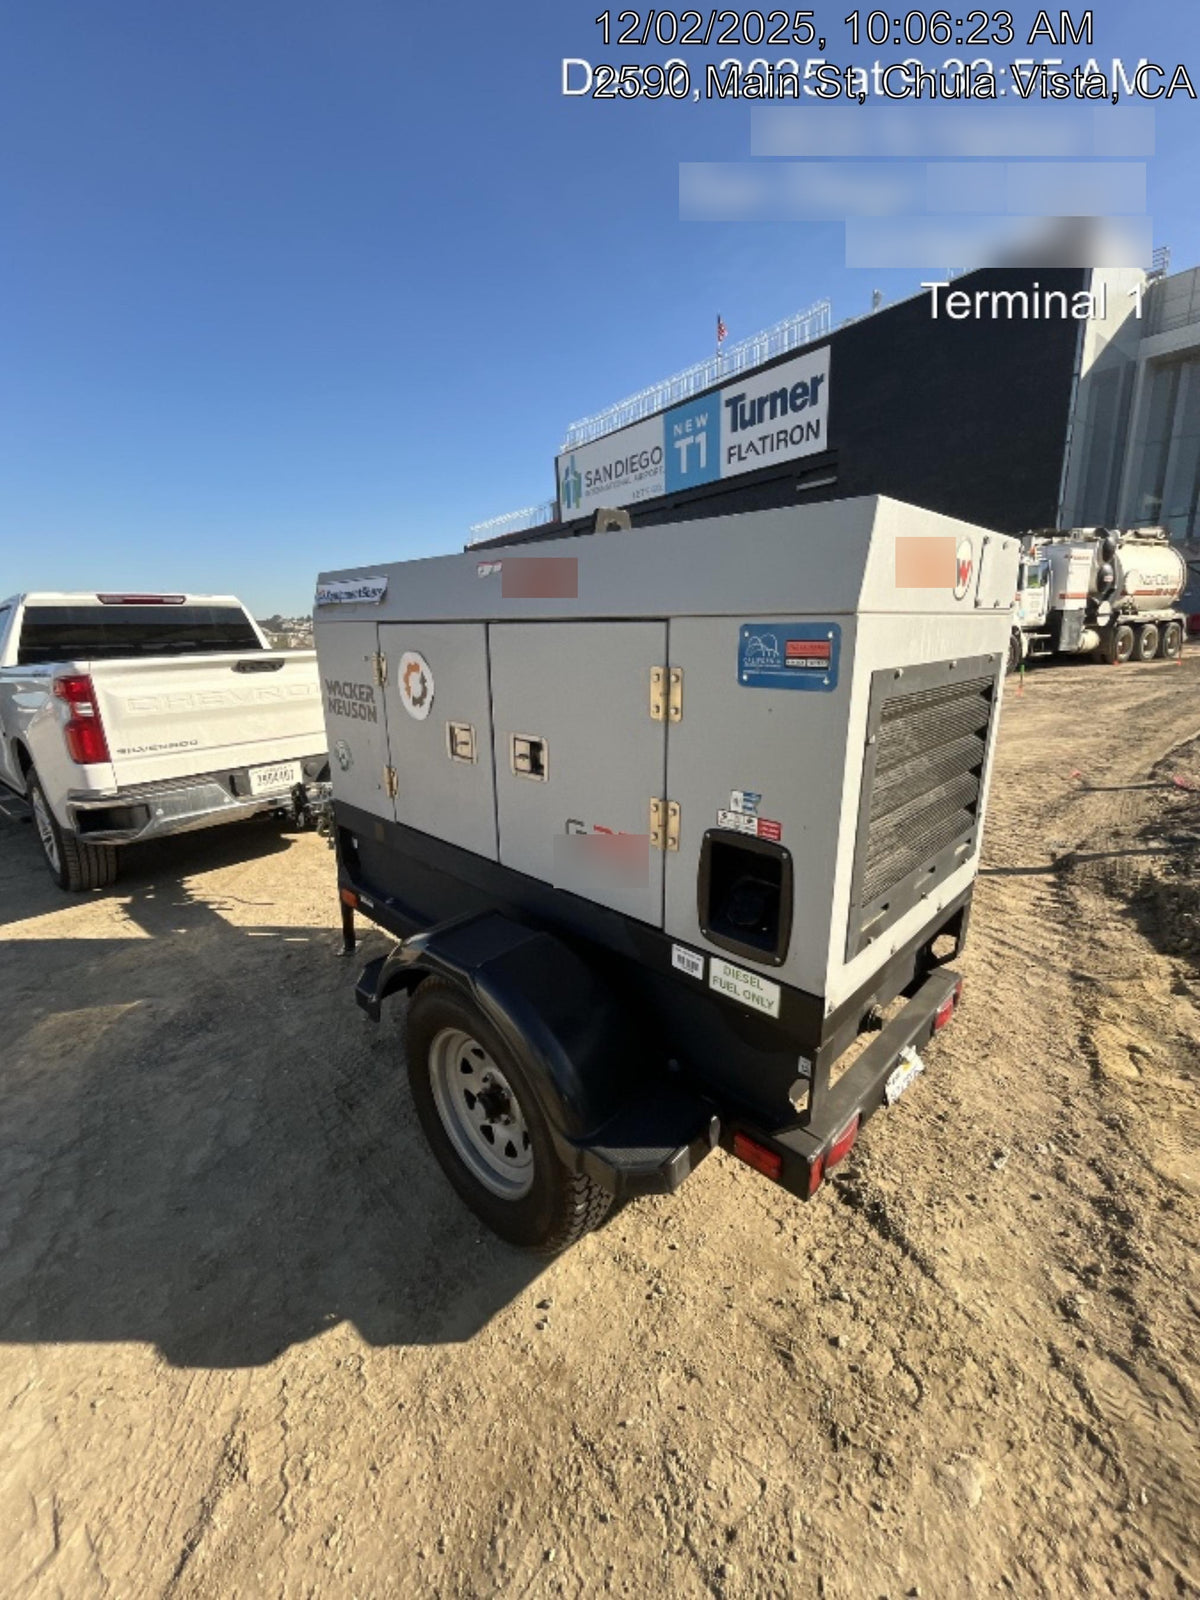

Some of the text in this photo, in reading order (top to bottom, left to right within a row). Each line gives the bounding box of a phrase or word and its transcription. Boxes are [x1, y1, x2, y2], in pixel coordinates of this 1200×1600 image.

[725, 373, 825, 434] Turner
[673, 412, 709, 436] NEW
[674, 431, 707, 473] T1
[727, 419, 821, 464] FLATIRON
[325, 679, 376, 703] WACKER
[328, 697, 378, 723] NEUSON
[712, 975, 775, 1010] FUEL ONLY
[723, 965, 764, 991] DIESEL
